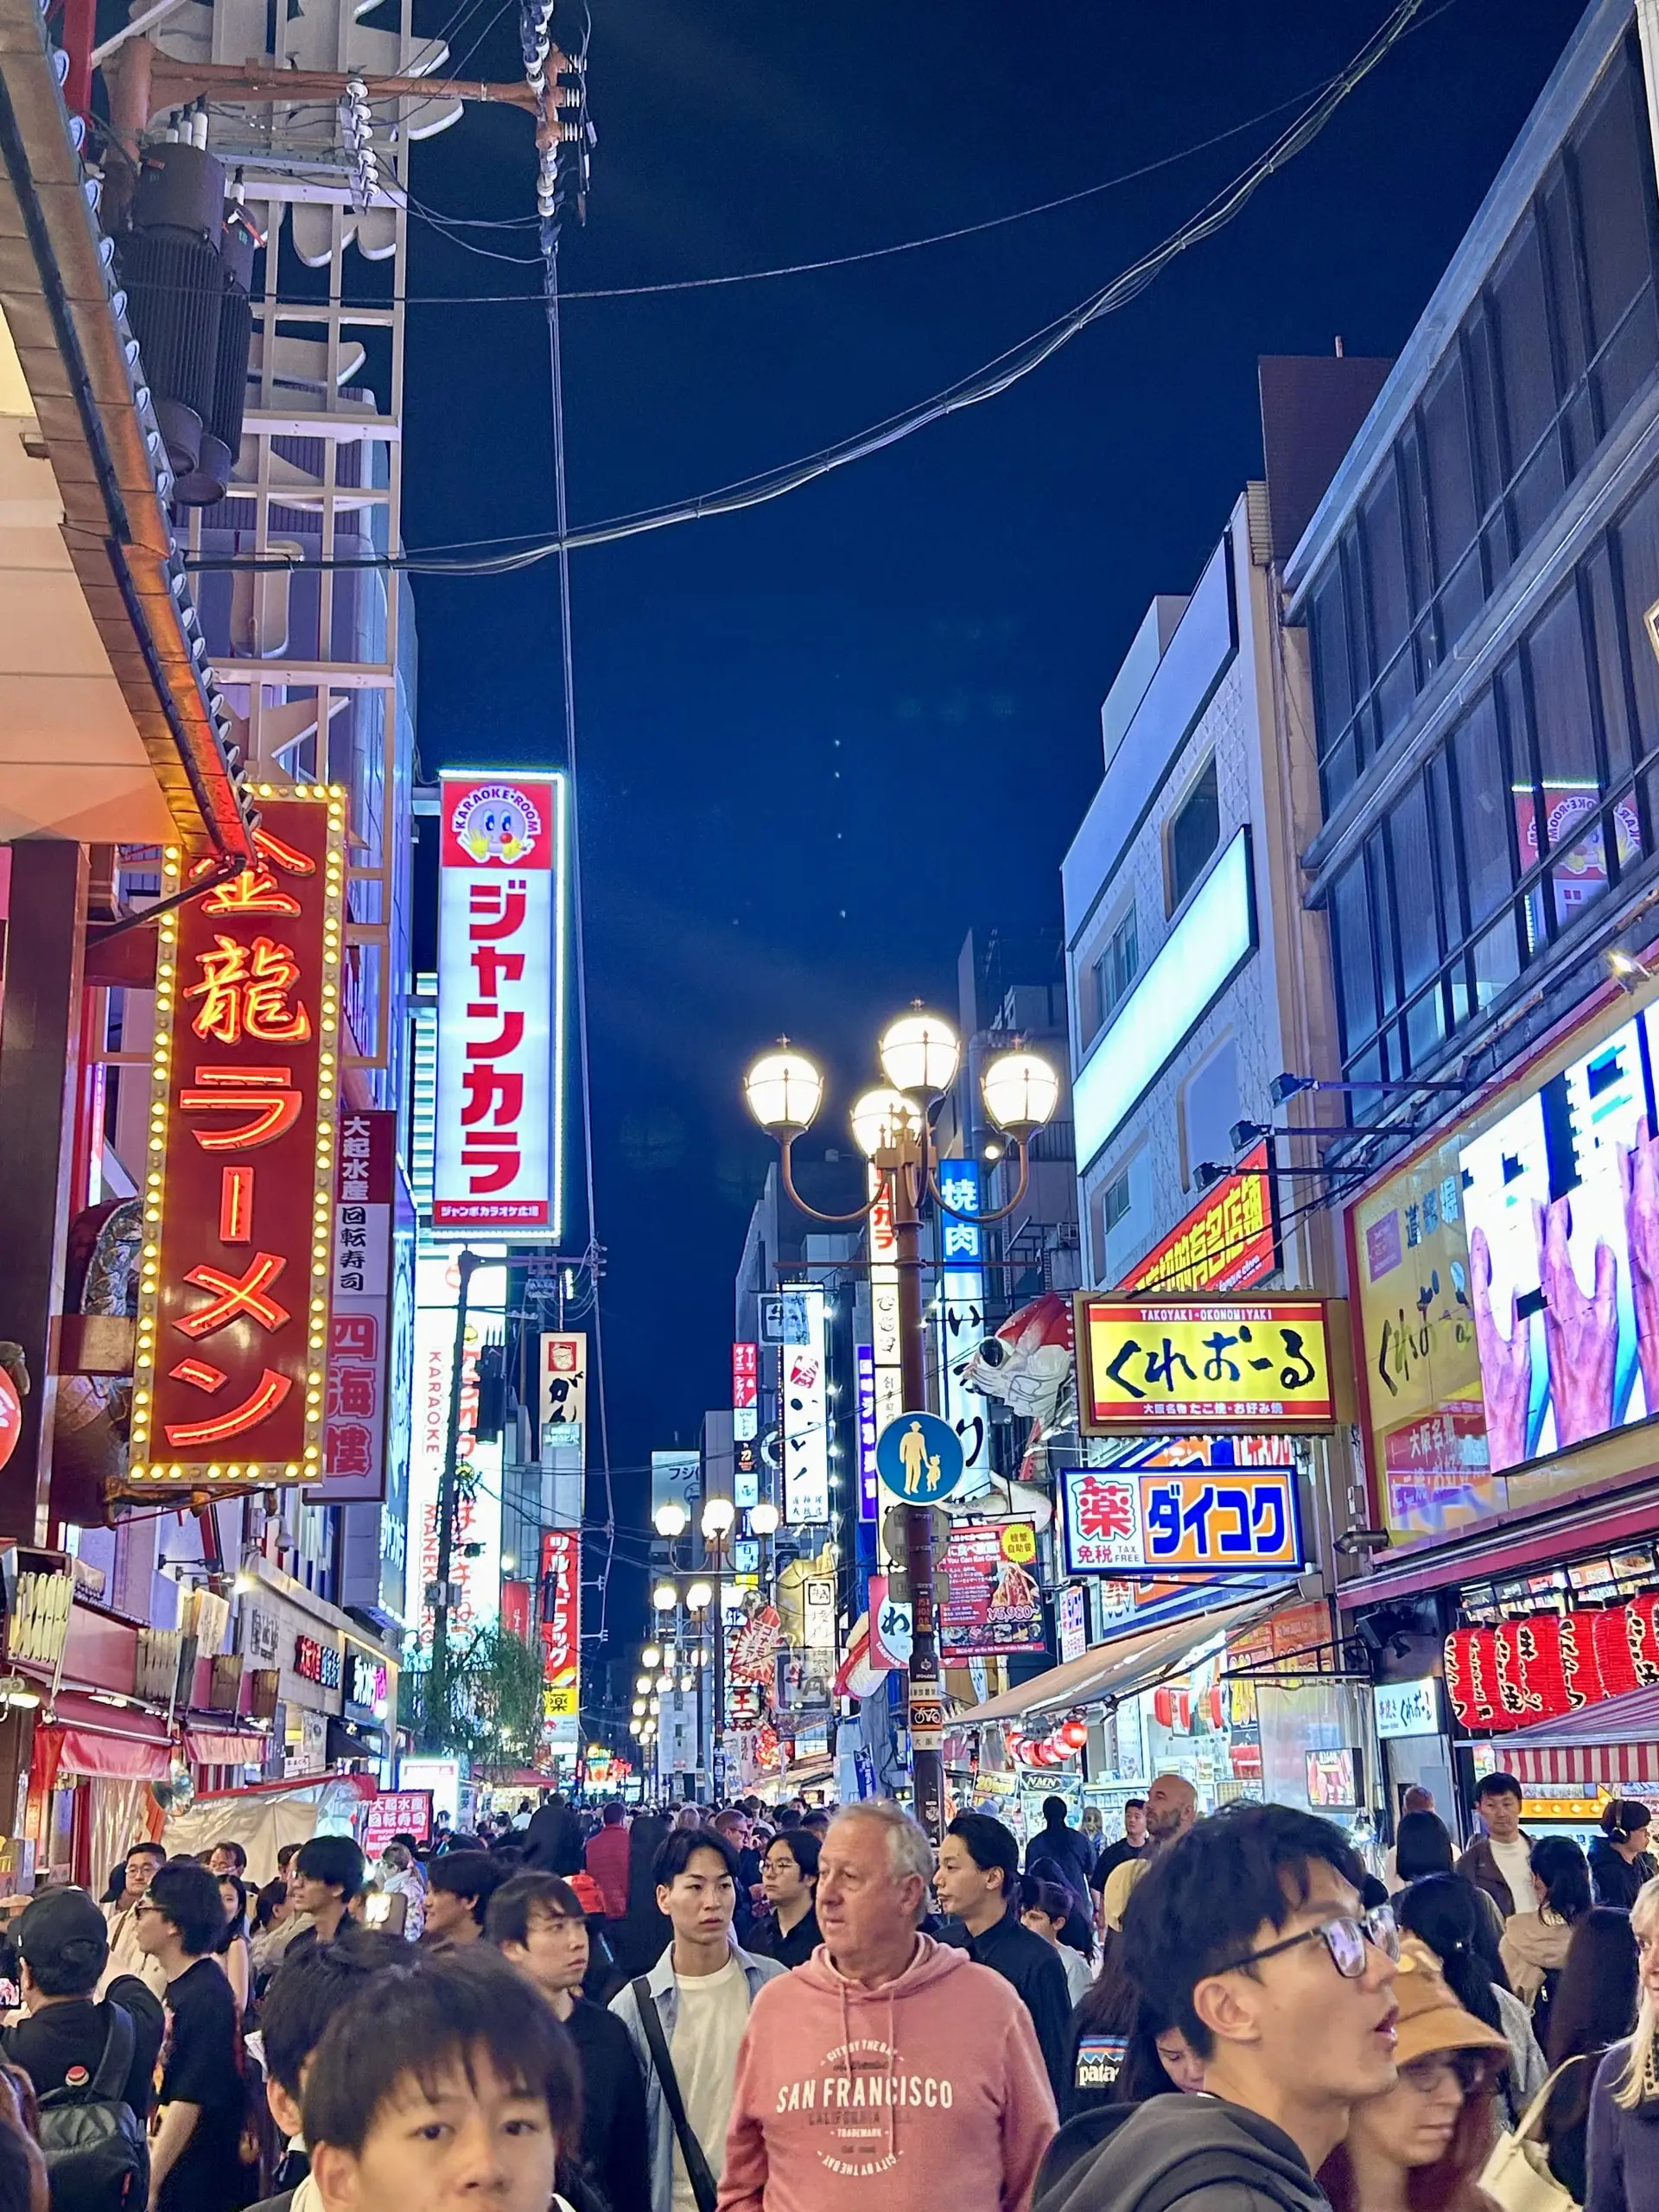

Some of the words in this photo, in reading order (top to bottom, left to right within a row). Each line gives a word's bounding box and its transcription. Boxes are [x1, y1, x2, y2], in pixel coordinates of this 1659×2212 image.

[461, 880, 527, 1193] ジャンカラ
[341, 1116, 371, 1200] 大起水産
[340, 1206, 366, 1291] 回転寿司
[941, 1179, 979, 1255] 焼肉
[1106, 1325, 1315, 1398] くれおーる
[426, 1351, 442, 1452] KARAOKE
[1079, 1477, 1129, 1536] 薬
[1149, 1484, 1282, 1554] ダイコク
[1077, 1545, 1112, 1563] 免税
[880, 1606, 910, 1636] わ
[1027, 1777, 1057, 1789] NMN
[826, 2044, 847, 2062] CITY
[861, 2039, 880, 2052] THE
[1079, 2063, 1120, 2086] pata
[777, 2079, 815, 2113] SAN
[823, 2075, 953, 2109] FRANCISCO
